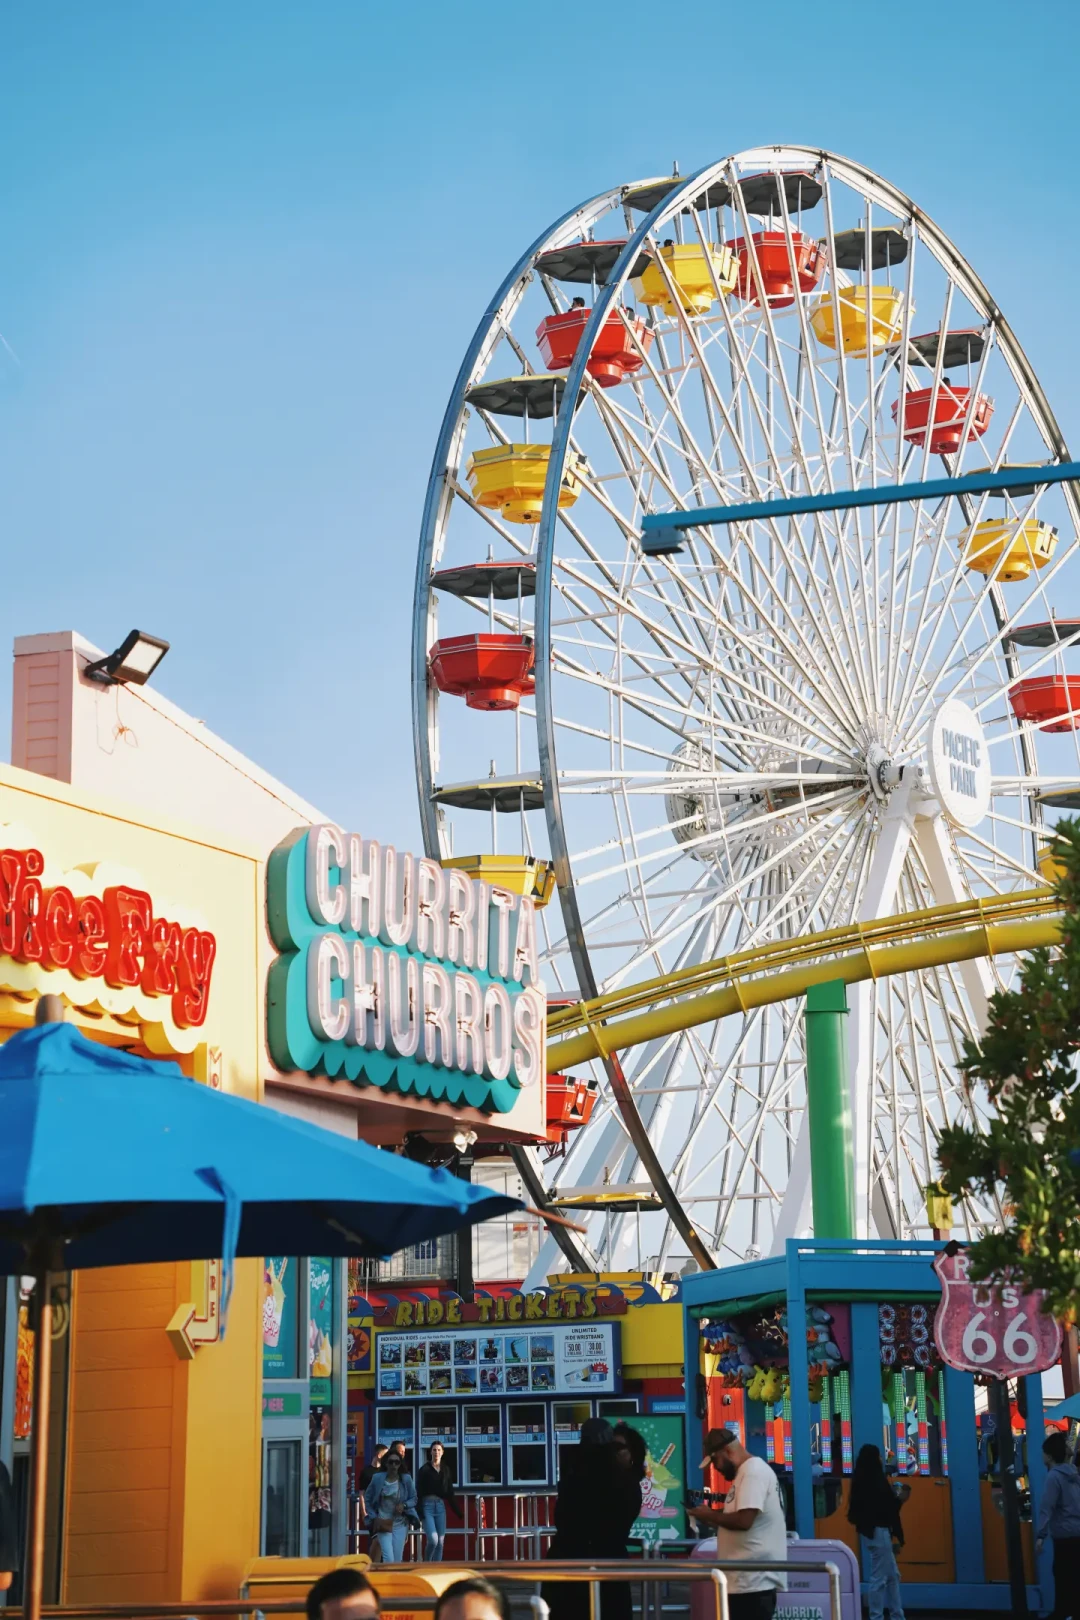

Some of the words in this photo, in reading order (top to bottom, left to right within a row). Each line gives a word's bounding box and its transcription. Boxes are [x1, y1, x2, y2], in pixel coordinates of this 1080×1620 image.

[942, 728, 980, 768] PACIFIC
[950, 763, 977, 799] PARK
[306, 823, 539, 987] CHURRITA
[306, 932, 539, 1088] CHURROS
[395, 1297, 463, 1327] RIDE
[476, 1290, 598, 1322] TICKETS
[962, 1311, 1038, 1364] 66
[628, 1529, 657, 1538] ZZY
